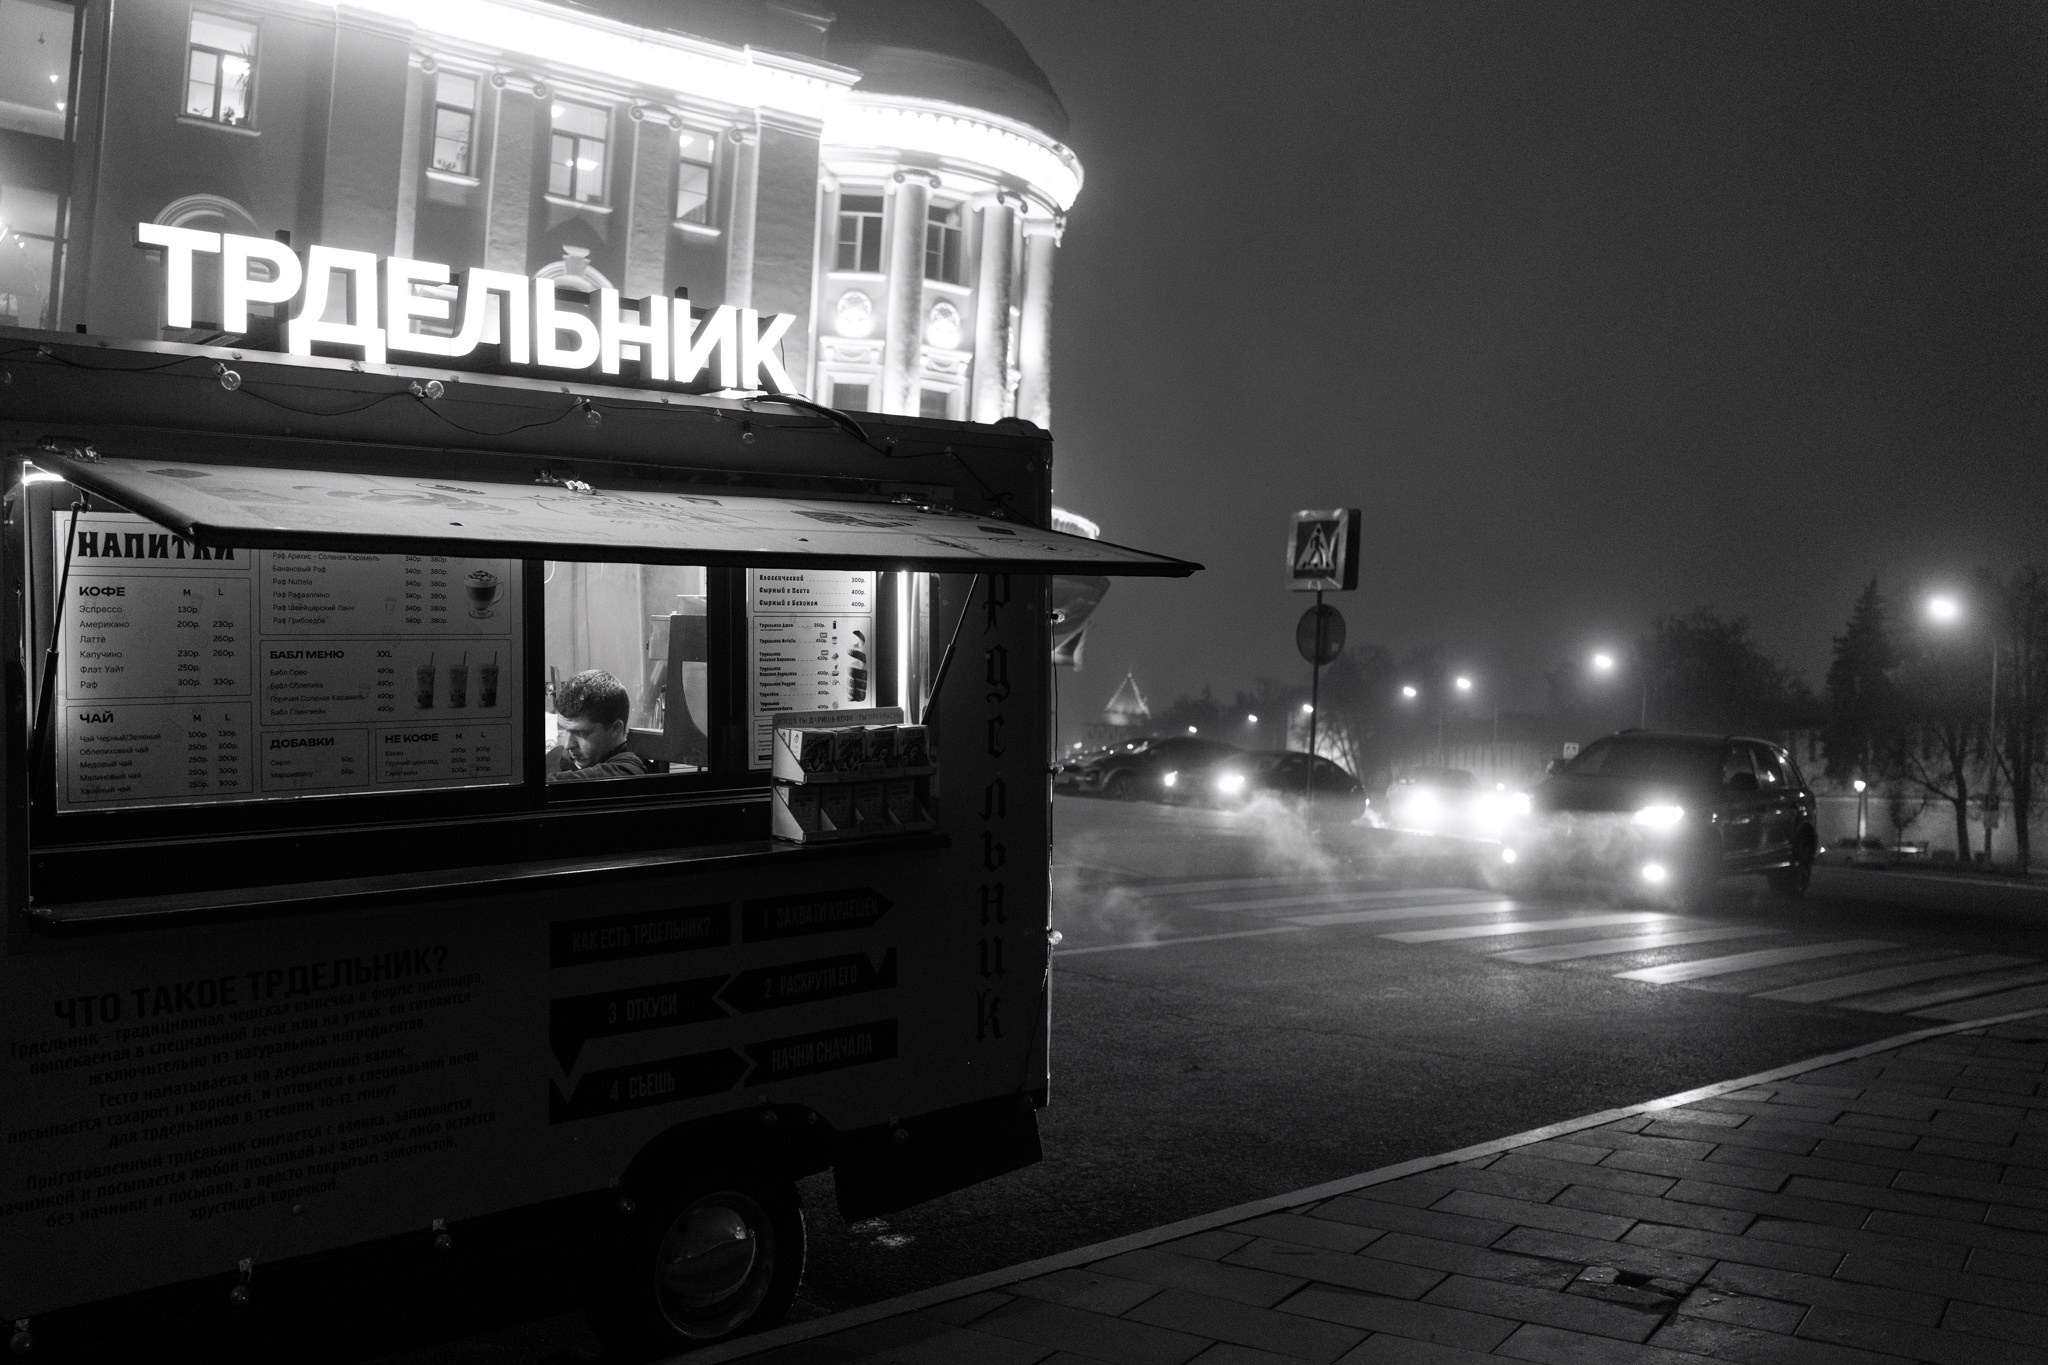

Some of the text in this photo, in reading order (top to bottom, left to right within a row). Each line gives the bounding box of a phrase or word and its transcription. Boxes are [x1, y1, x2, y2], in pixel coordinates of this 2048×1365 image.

[135, 222, 796, 396] ТРДЕЛЬНИК
[272, 552, 286, 560] Раф
[79, 586, 126, 596] КОФЕ
[80, 605, 122, 614] Эспрессо
[272, 604, 286, 612] Раф
[80, 620, 130, 630] Американо
[272, 617, 286, 625] Раф
[80, 636, 106, 644] Латте
[80, 650, 122, 659] Капучино
[270, 650, 304, 659] БАБЛ
[306, 650, 344, 659] МЕНЮ
[80, 666, 102, 674] Флэт
[104, 665, 124, 674] Уайт
[80, 680, 98, 690] Раф
[80, 710, 114, 724] ЧАЙ
[270, 737, 334, 750] ДОБАВКИ
[385, 734, 401, 744] НЕ
[404, 734, 439, 743] КОФЕ
[80, 761, 116, 770] Медовый
[80, 773, 126, 782] Малиновый
[776, 902, 827, 928] ЗАХВАТИ
[828, 896, 878, 922] КРАЕШЕК
[572, 916, 712, 952] КАК ЕСТЬ ТРДЕЛЬНИК?
[55, 945, 448, 1028] ЧТО ТАКОЕ ТРДЕЛЬНИК?
[764, 964, 858, 998] 2 РАСКРУТИ ЕГО
[608, 994, 677, 1024] 3 ОТКУСИ
[10, 1033, 98, 1059] Трдельник
[116, 1013, 224, 1042] традиционная
[230, 1002, 290, 1021] чешская
[295, 994, 354, 1013] выпечка
[360, 990, 366, 1002] в
[372, 981, 414, 1002] форме
[30, 1048, 130, 1075] выпекаемая
[136, 1046, 144, 1058] в
[150, 1026, 247, 1056] специальной
[252, 1023, 286, 1038] печи
[292, 1018, 318, 1032] или
[323, 1016, 338, 1026] на
[390, 1004, 405, 1016] он
[410, 992, 472, 1012] готовится
[771, 1034, 873, 1072] НАЧНИ СНАЧАЛА
[98, 1092, 138, 1108] Тесто
[144, 1071, 248, 1100] наматывается
[254, 1070, 270, 1082] на
[274, 1048, 360, 1080] деревянный
[608, 1072, 676, 1102] 4 СЪЕШЬ
[27, 1153, 162, 1192] Приготовленный
[168, 1140, 246, 1166] трдельник
[250, 1126, 322, 1150] снимается
[394, 1098, 472, 1122] заполняется
